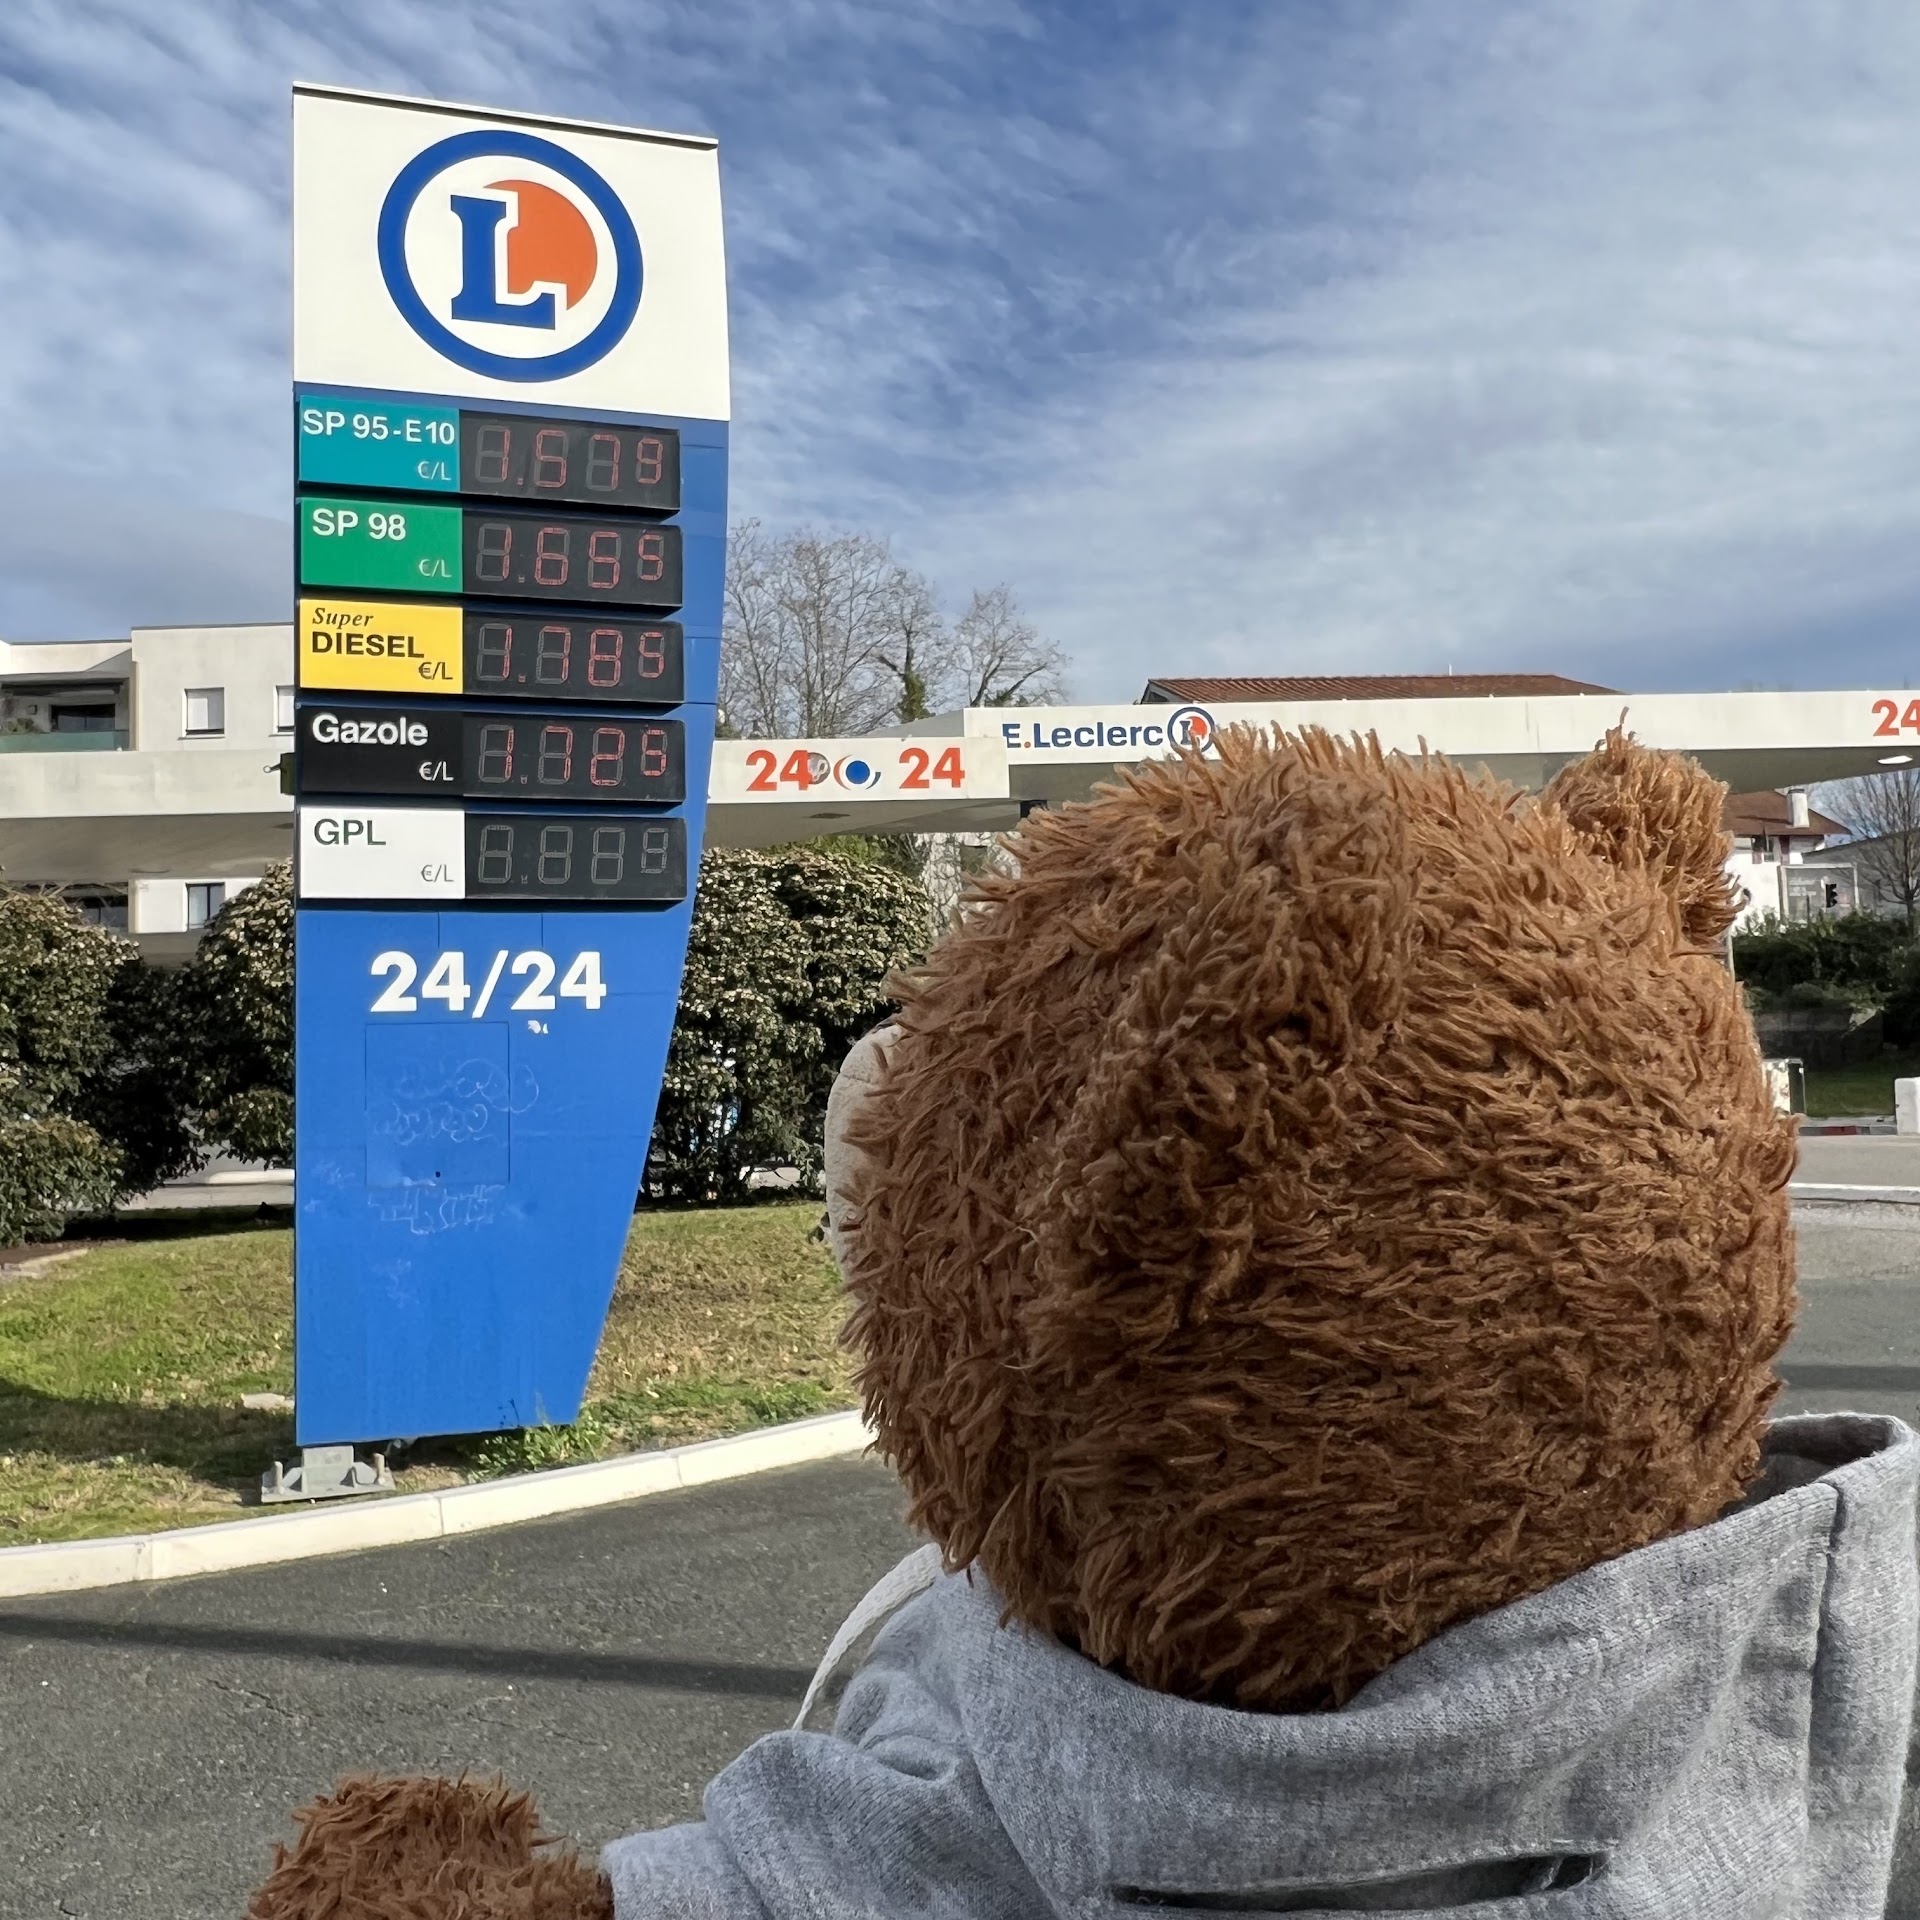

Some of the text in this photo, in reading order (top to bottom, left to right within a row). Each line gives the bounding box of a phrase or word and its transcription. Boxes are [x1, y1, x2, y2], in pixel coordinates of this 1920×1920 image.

[450, 194, 556, 331] L
[303, 409, 346, 436] SP
[417, 460, 452, 481] €/L
[502, 428, 665, 491] 1.579
[312, 508, 406, 541] SP 98
[418, 558, 452, 578] €/L
[502, 526, 665, 589] 1.655
[312, 607, 374, 628] Super
[312, 631, 425, 658] DIESEL
[502, 625, 666, 688] 1.785
[418, 661, 454, 681] €/L
[312, 713, 428, 746] Gazole
[1872, 698, 1920, 737] 24
[1002, 721, 1164, 749] E.Leclerc
[418, 760, 454, 782] €/L
[503, 725, 667, 787] 1.725
[745, 749, 811, 792] 24
[898, 747, 966, 789] 24
[313, 818, 387, 846] GPL
[420, 863, 454, 884] €/L
[369, 949, 607, 1019] 24/24
